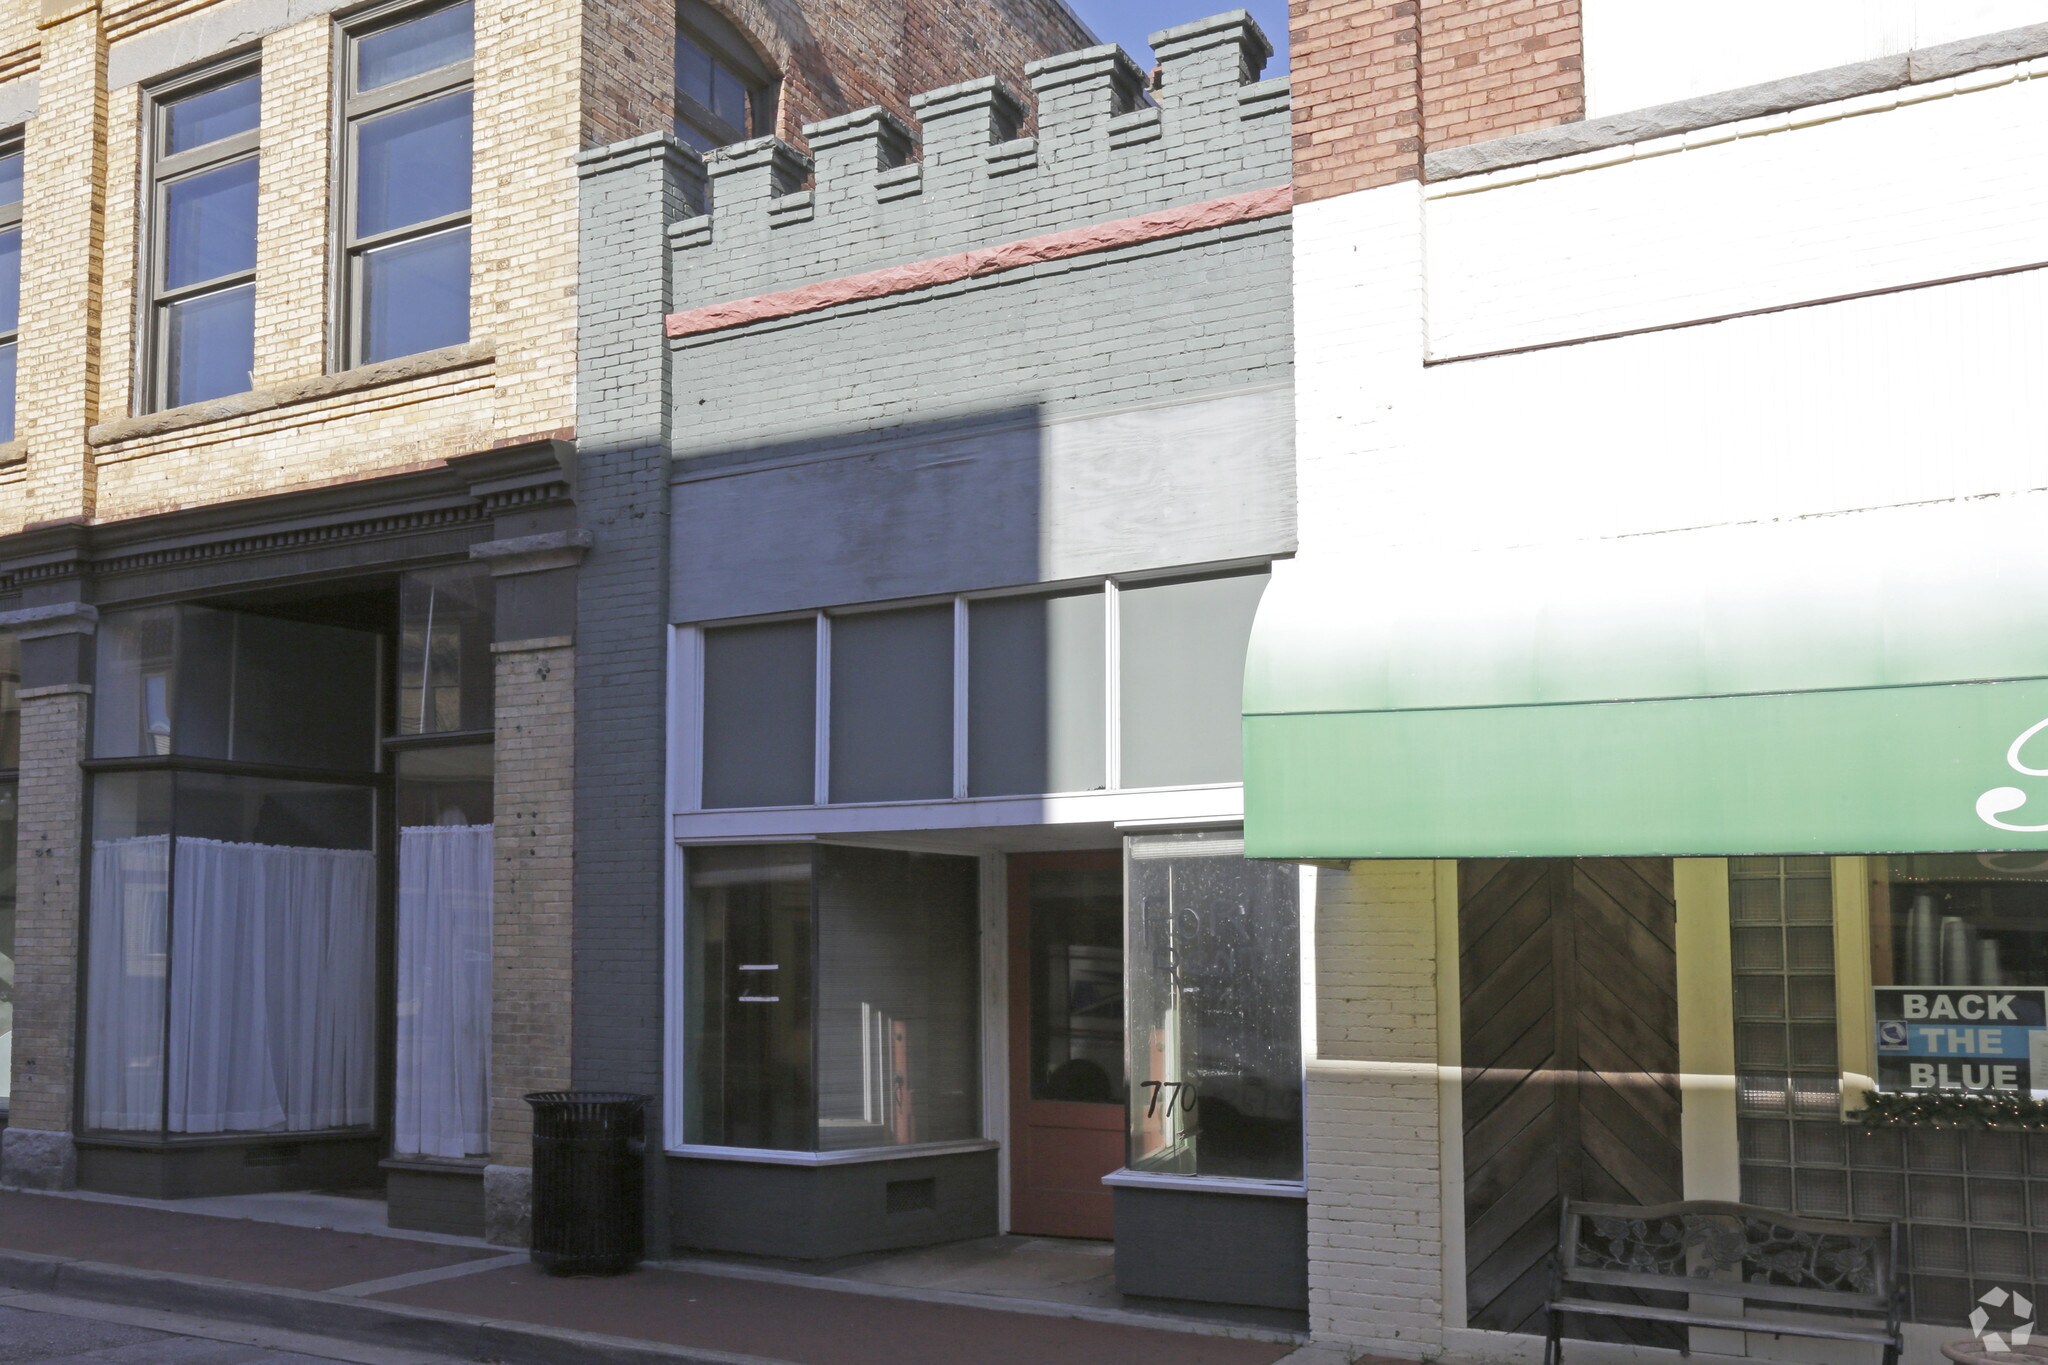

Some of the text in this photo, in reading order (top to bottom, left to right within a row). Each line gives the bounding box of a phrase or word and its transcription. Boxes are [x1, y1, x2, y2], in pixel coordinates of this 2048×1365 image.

[1903, 994, 2018, 1020] BACK
[1919, 1028, 2003, 1054] THE
[1910, 1063, 2018, 1090] BLUE
[1140, 1081, 1197, 1118] 770
